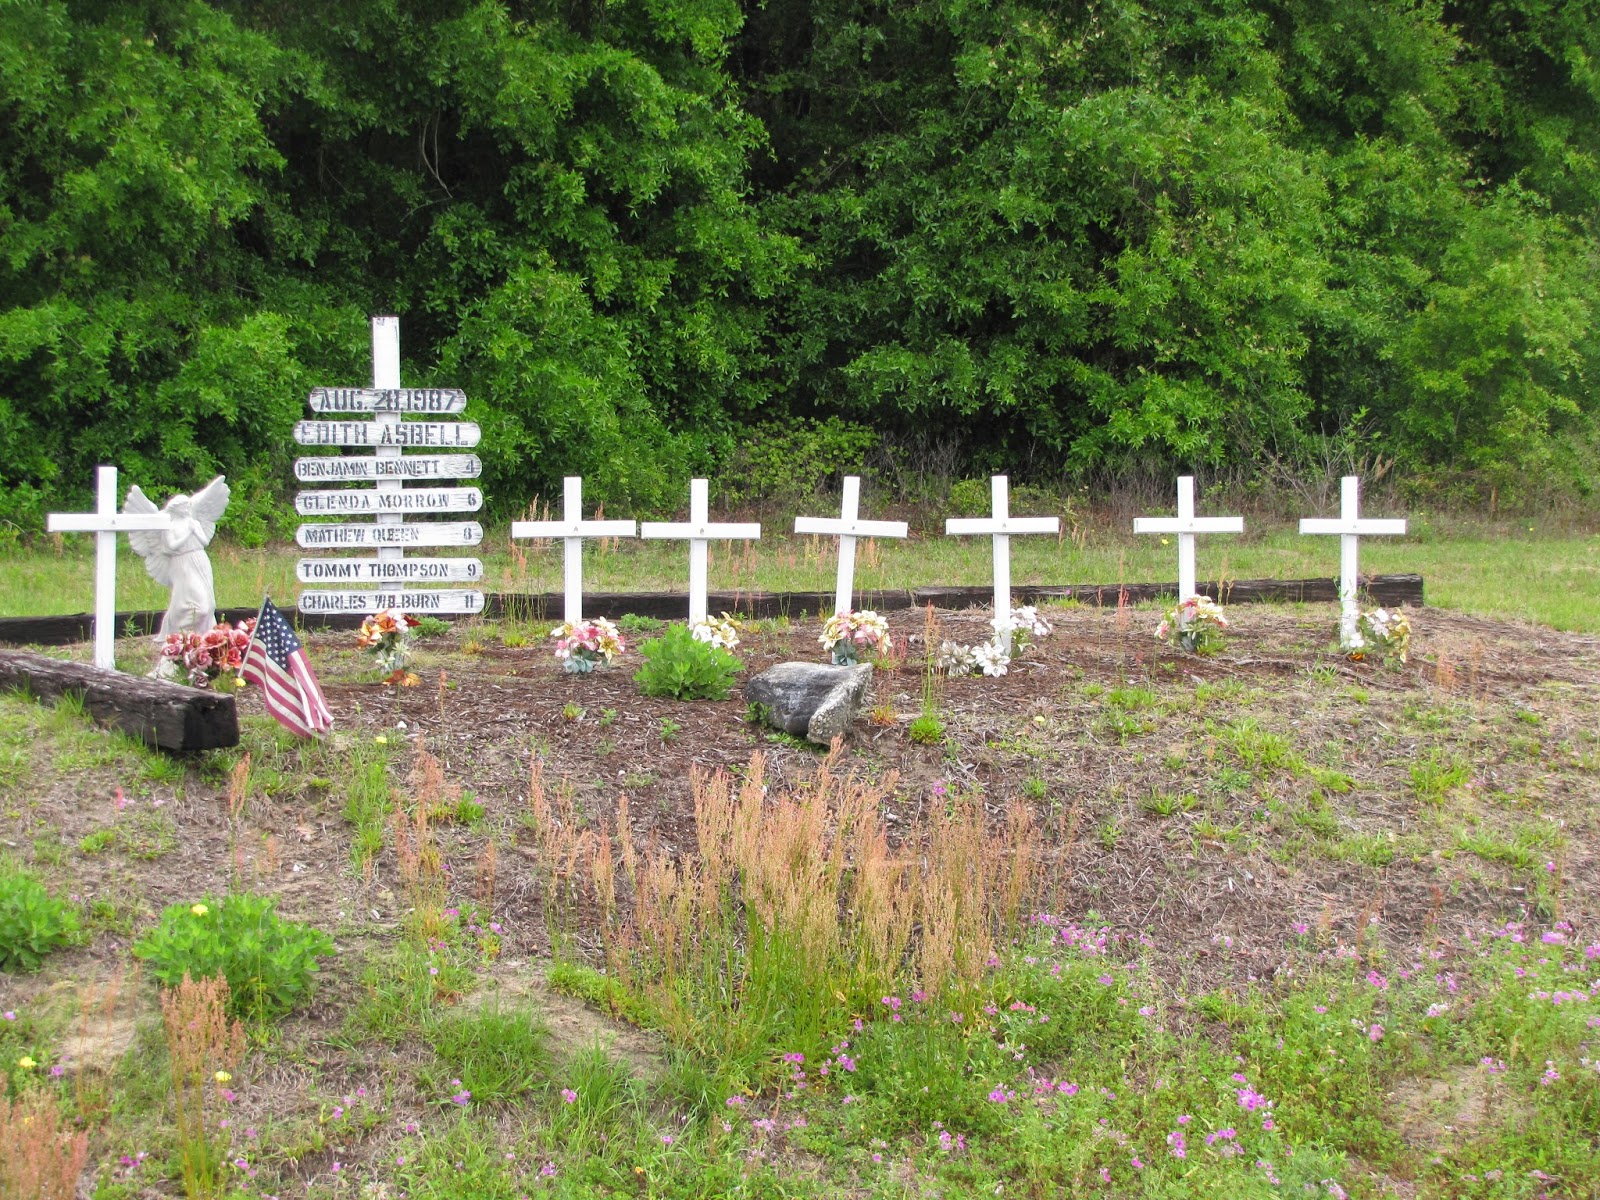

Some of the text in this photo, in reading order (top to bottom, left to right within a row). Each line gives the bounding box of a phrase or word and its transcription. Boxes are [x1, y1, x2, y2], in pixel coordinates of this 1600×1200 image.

[319, 389, 368, 411] AUG.
[301, 423, 468, 446] EDITH ASBELL
[298, 459, 475, 477] BENJAMIN BENNETT 4
[303, 493, 477, 510] GLENDA MORROW 6
[305, 527, 473, 543] MATHEW QUEEN 8
[303, 563, 477, 578] TOMMY THOMPSON 9
[302, 595, 367, 610] CHARLES
[464, 594, 474, 609] 11
